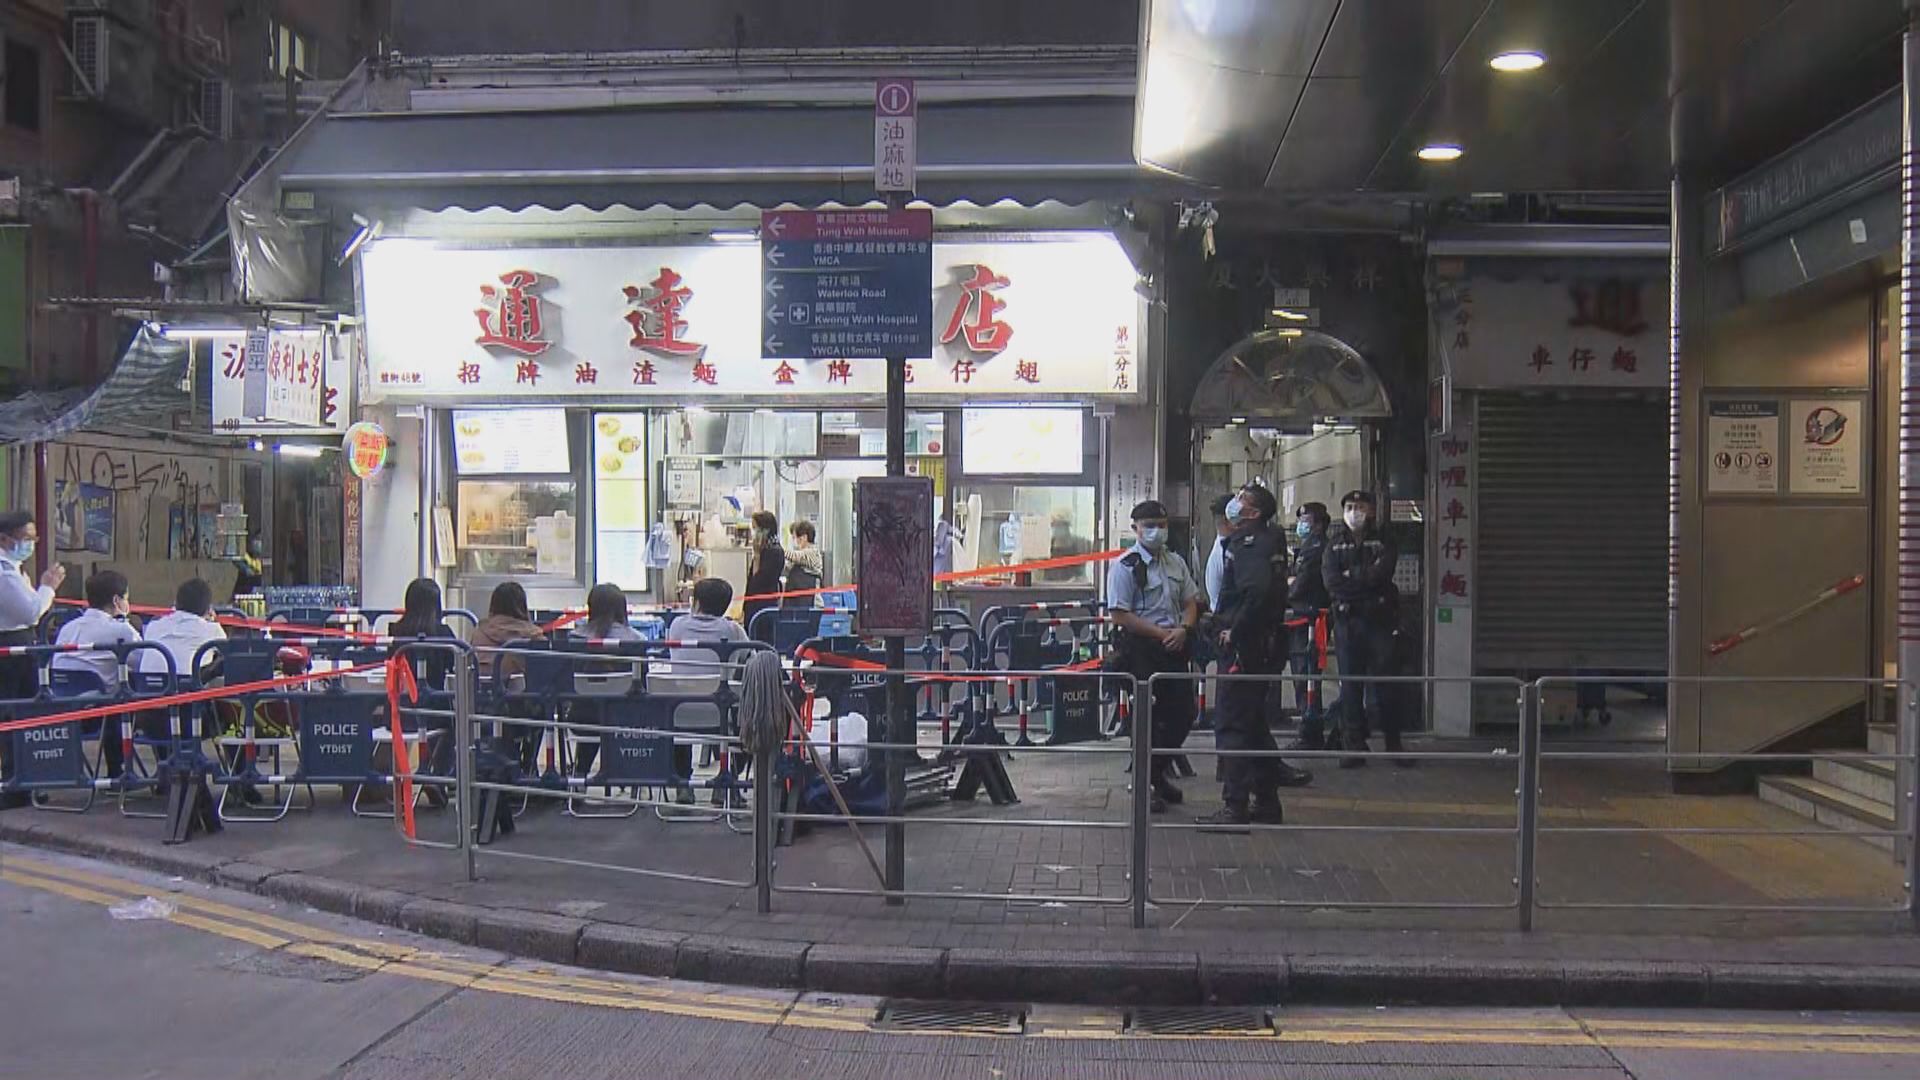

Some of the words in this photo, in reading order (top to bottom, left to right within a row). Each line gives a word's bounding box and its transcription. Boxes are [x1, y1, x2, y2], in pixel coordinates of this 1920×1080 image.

[883, 120, 905, 187] 油麻地
[816, 227, 841, 238] Tung
[843, 227, 865, 236] Wah
[867, 226, 909, 236] Museum
[813, 256, 840, 265] YMCA
[817, 288, 859, 297] Waterloo
[861, 288, 886, 297] Road
[815, 315, 849, 326] Kwong
[852, 314, 874, 323] Wah
[876, 314, 918, 326] Hospital
[811, 347, 840, 355] YWCA
[842, 346, 881, 356] (15mins)
[1063, 690, 1089, 703] POLICE
[24, 727, 70, 742] POLICE
[313, 723, 358, 736] POLICE
[32, 748, 64, 760] YTDIST
[319, 744, 353, 754] YTDIST
[619, 747, 655, 758] YTDIST
